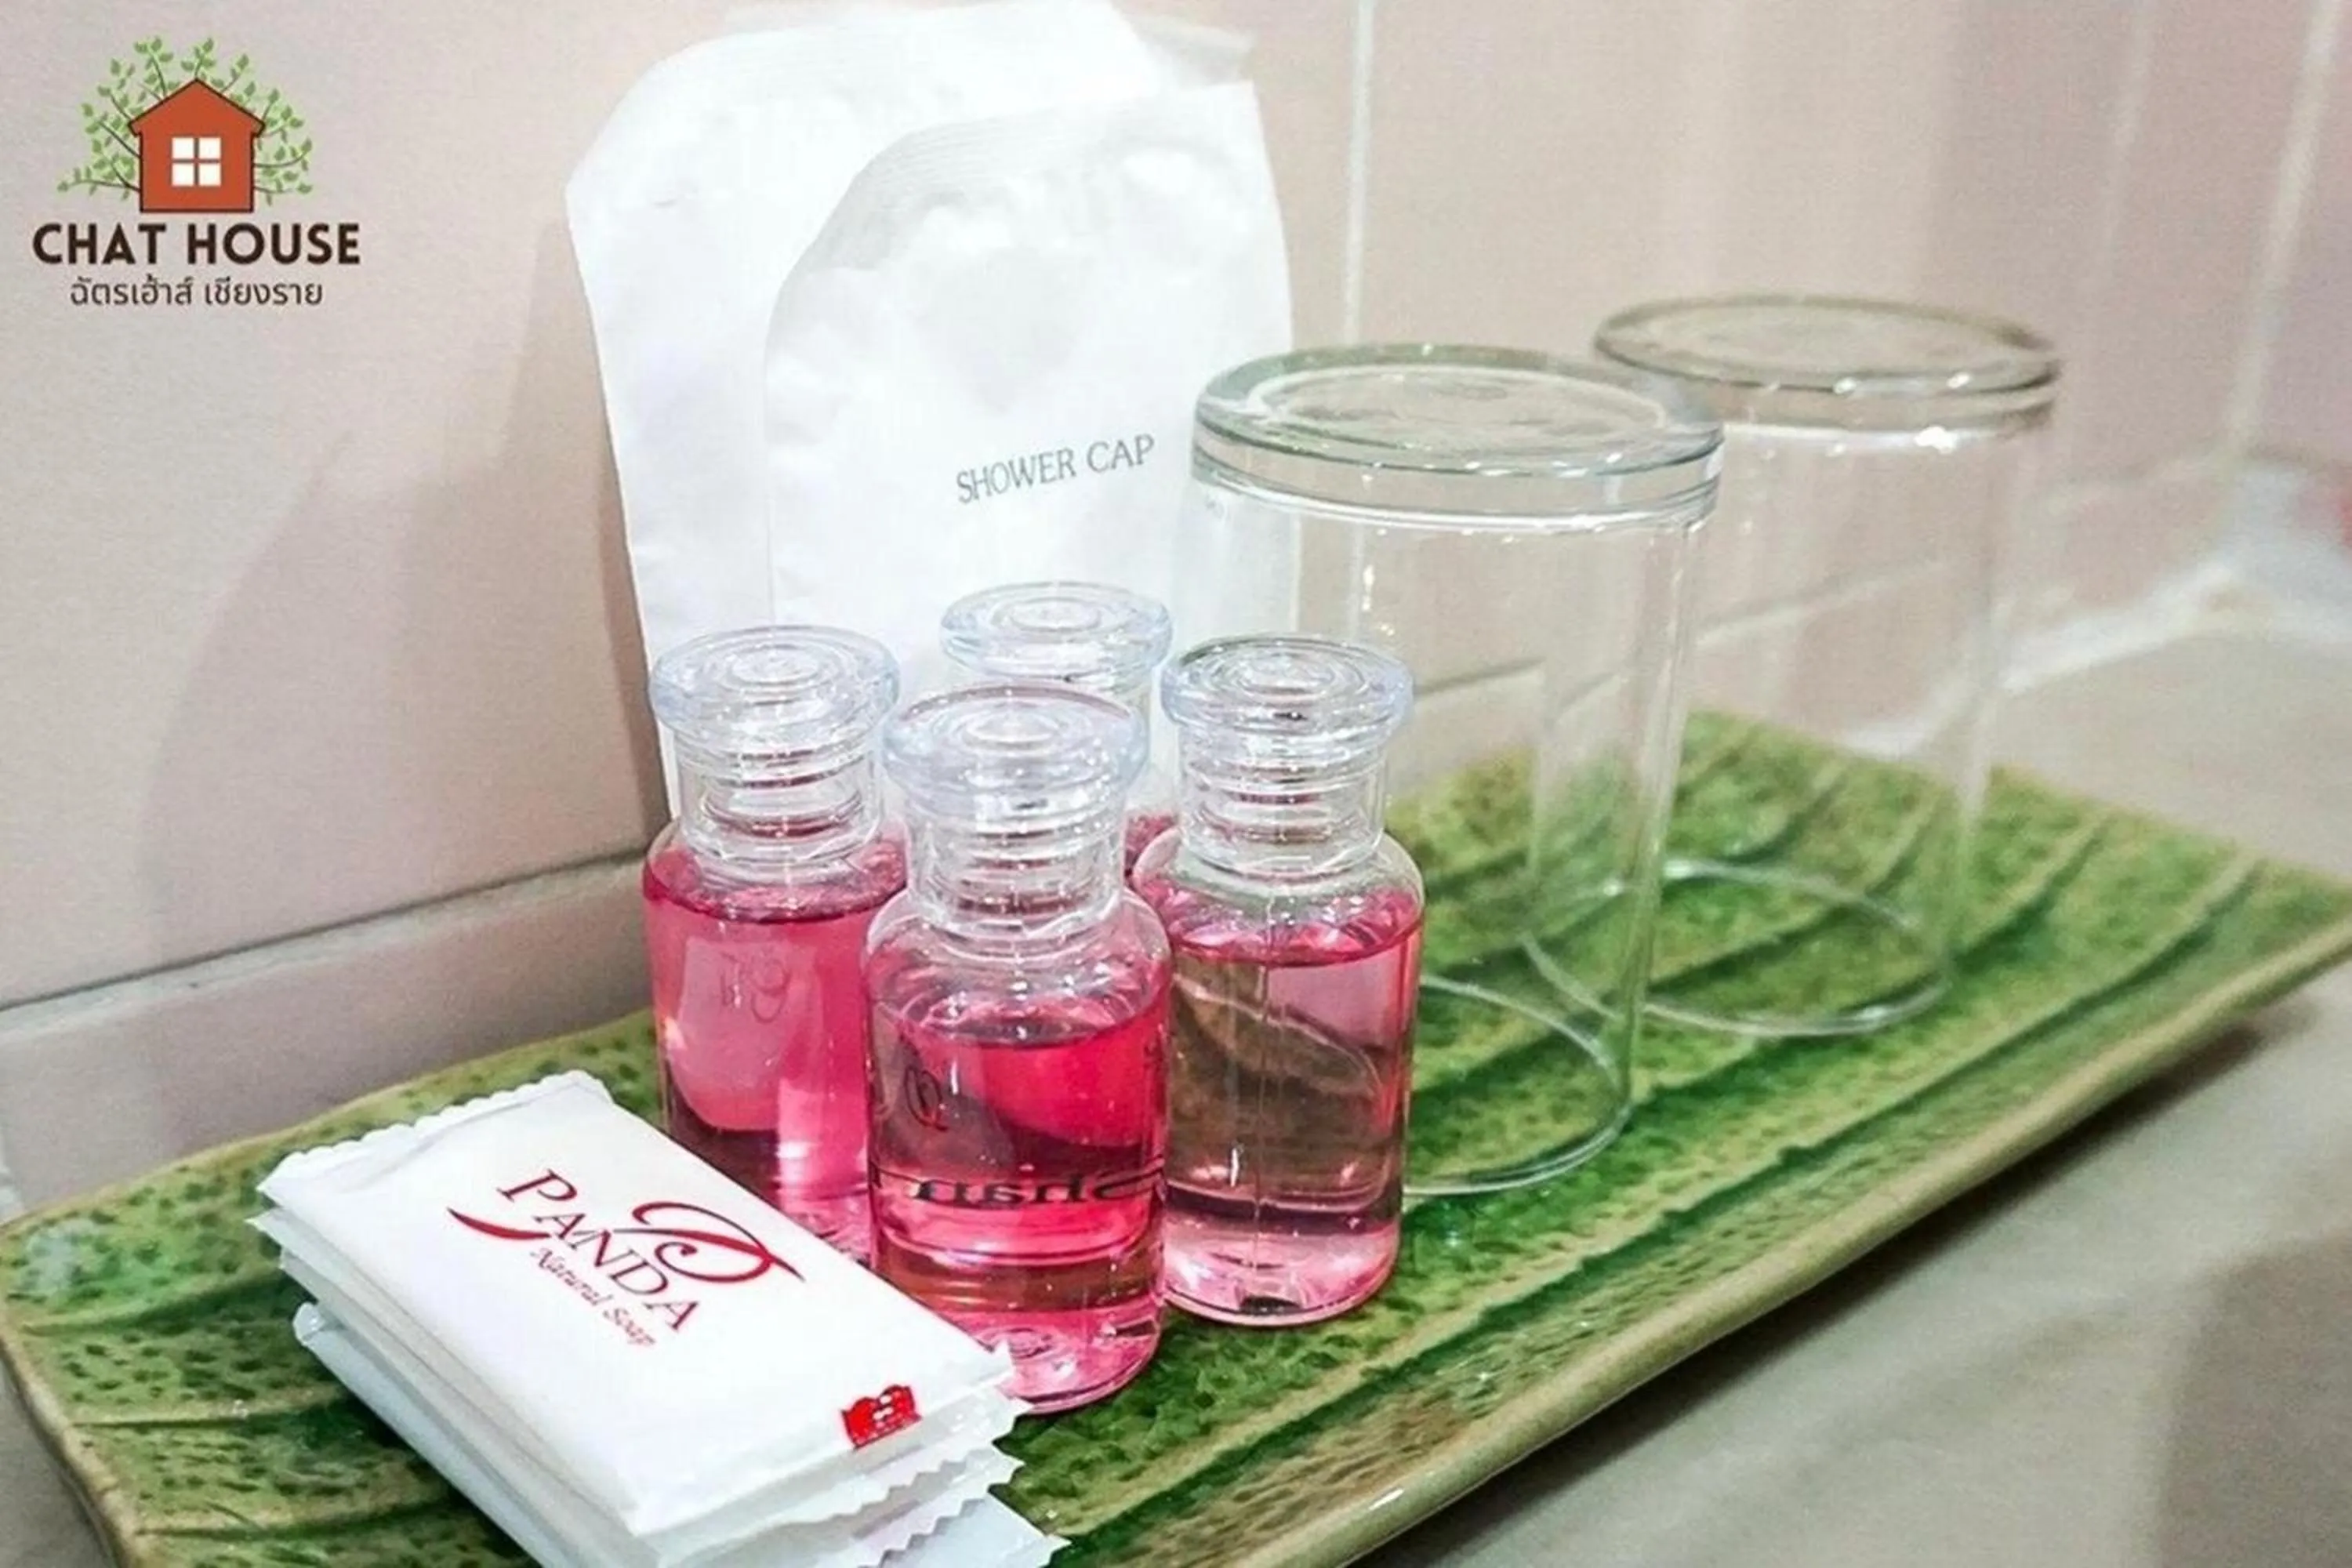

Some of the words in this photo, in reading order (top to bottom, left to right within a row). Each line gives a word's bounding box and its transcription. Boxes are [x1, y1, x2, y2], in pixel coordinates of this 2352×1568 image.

[956, 448, 1077, 504] SHOWER
[1086, 433, 1155, 474] CAP
[497, 1168, 699, 1331] PANDA
[529, 1247, 614, 1308] Natural
[602, 1308, 656, 1346] Soap
